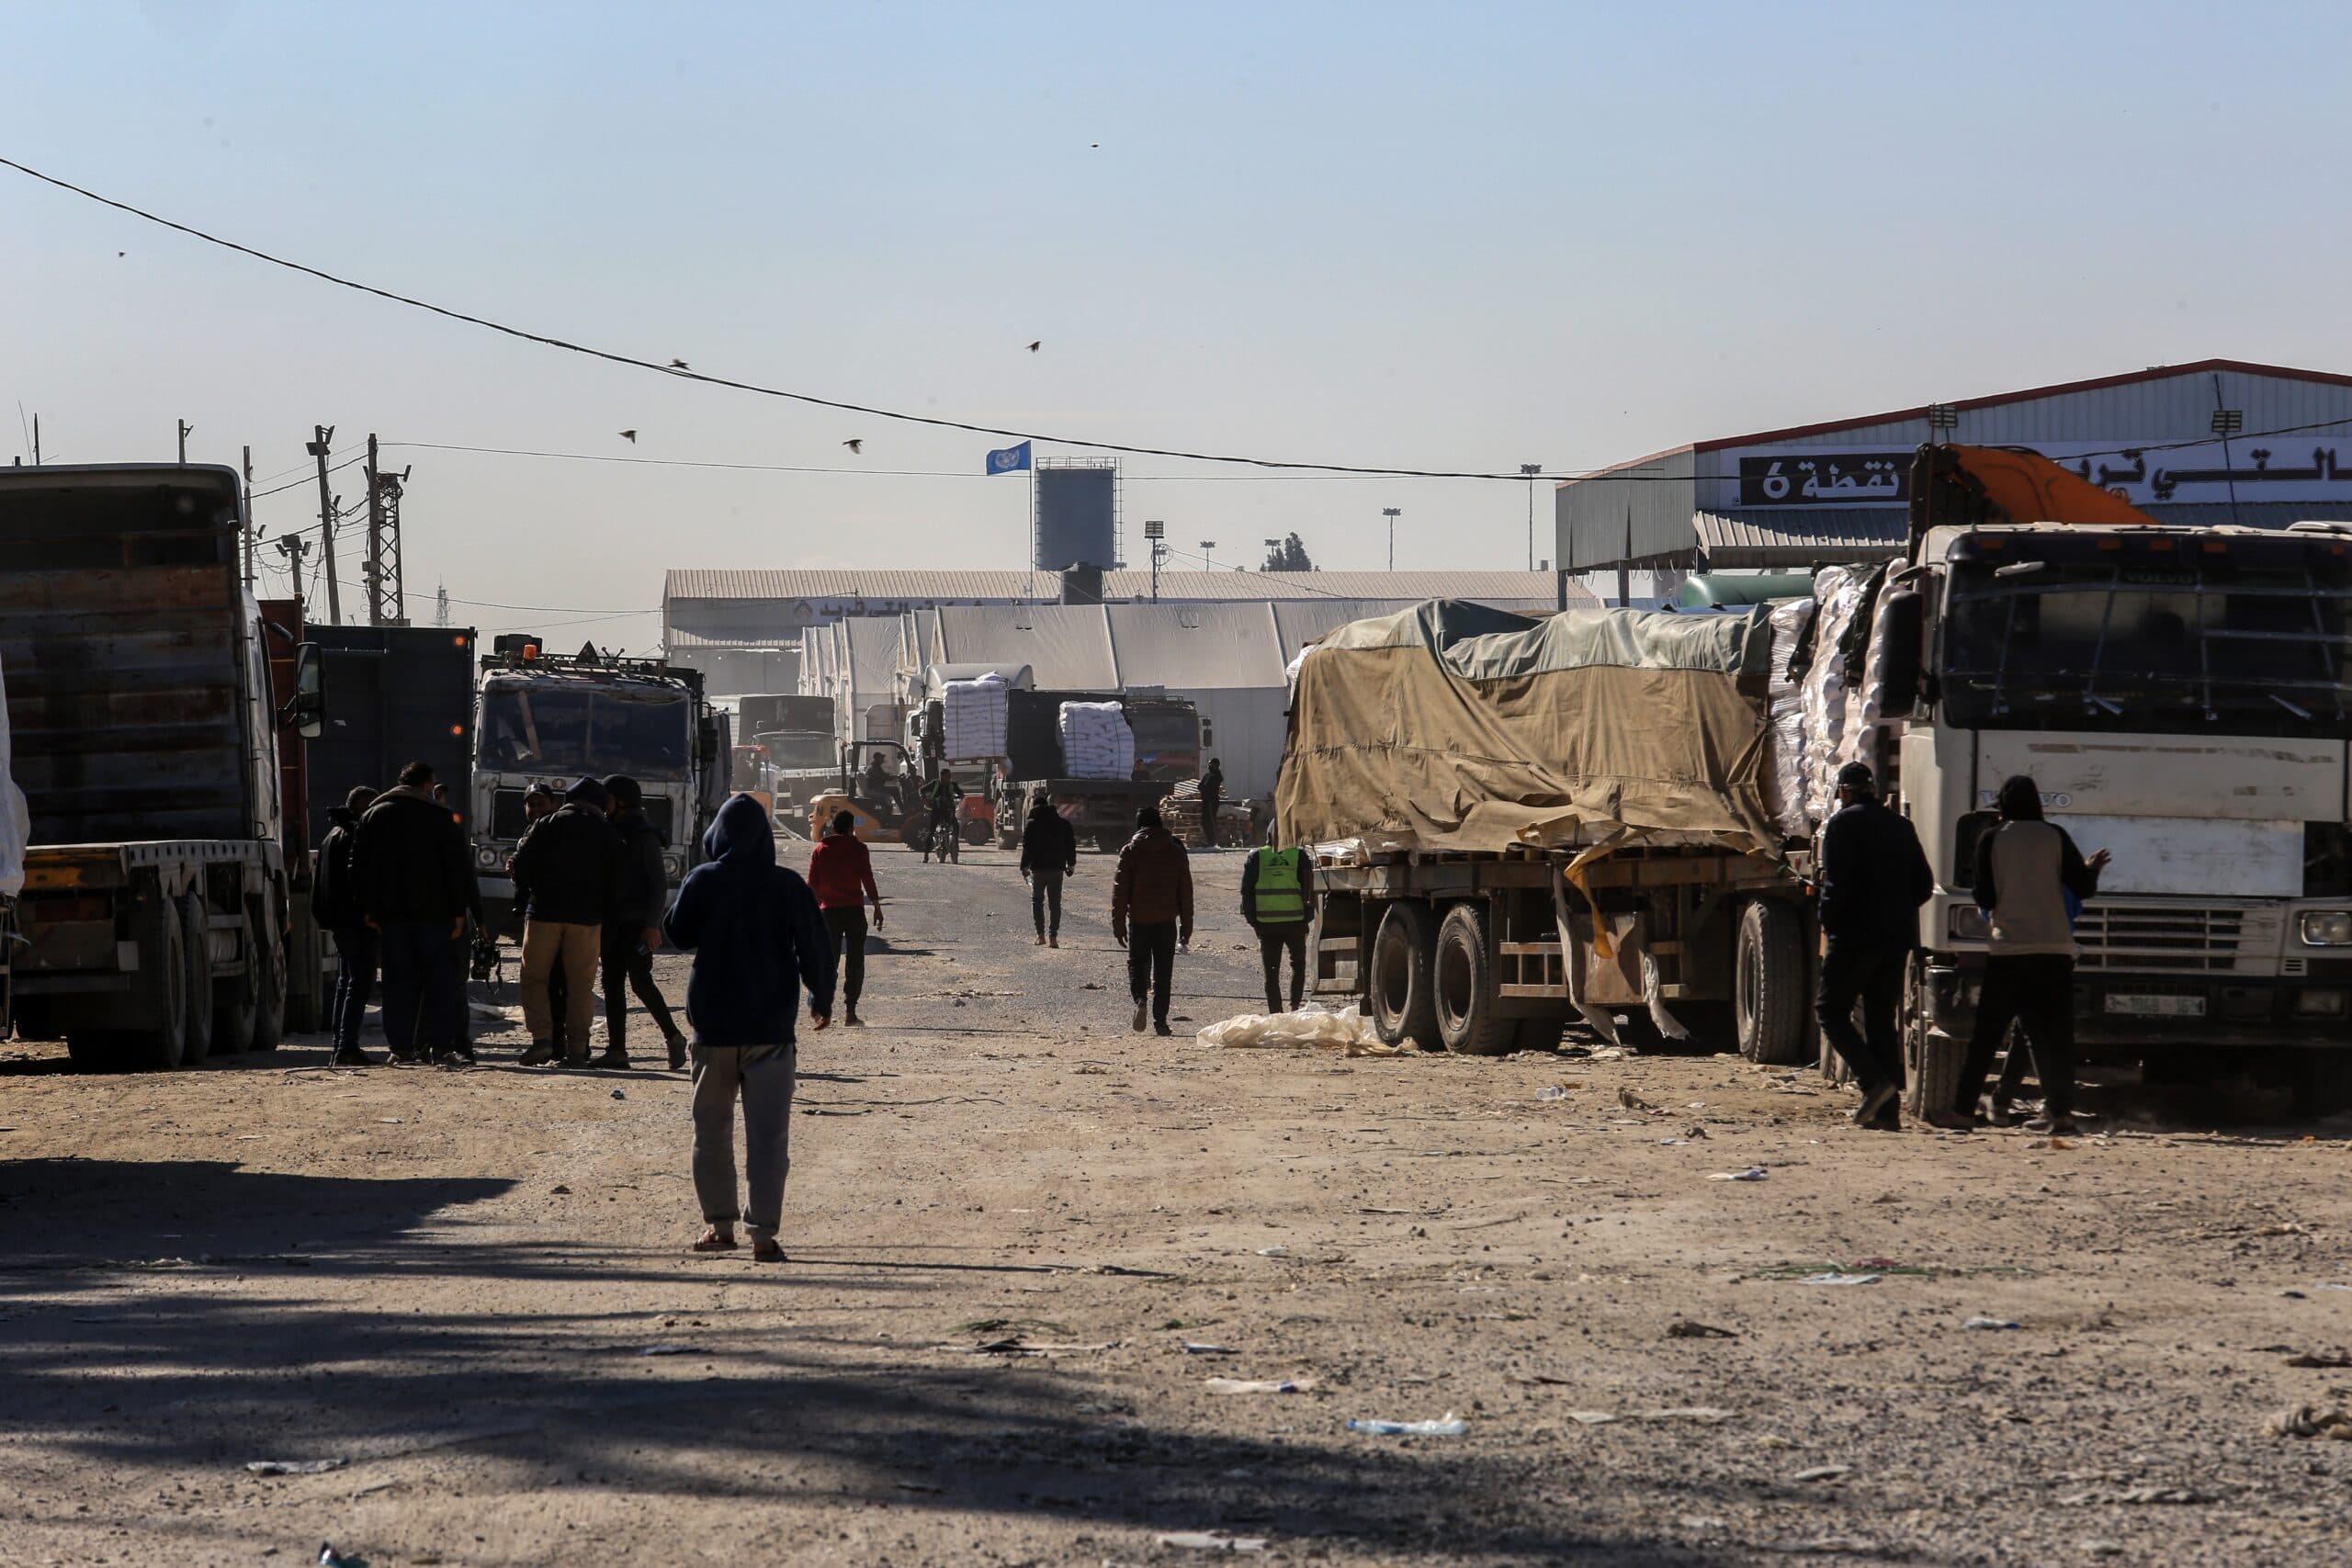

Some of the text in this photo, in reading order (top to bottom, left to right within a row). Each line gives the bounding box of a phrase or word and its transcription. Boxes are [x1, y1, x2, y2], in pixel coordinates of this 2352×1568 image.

[1763, 461, 1899, 499] نقطة 6
[2125, 572, 2193, 583] VOLVO
[1977, 790, 2072, 807] VVO
